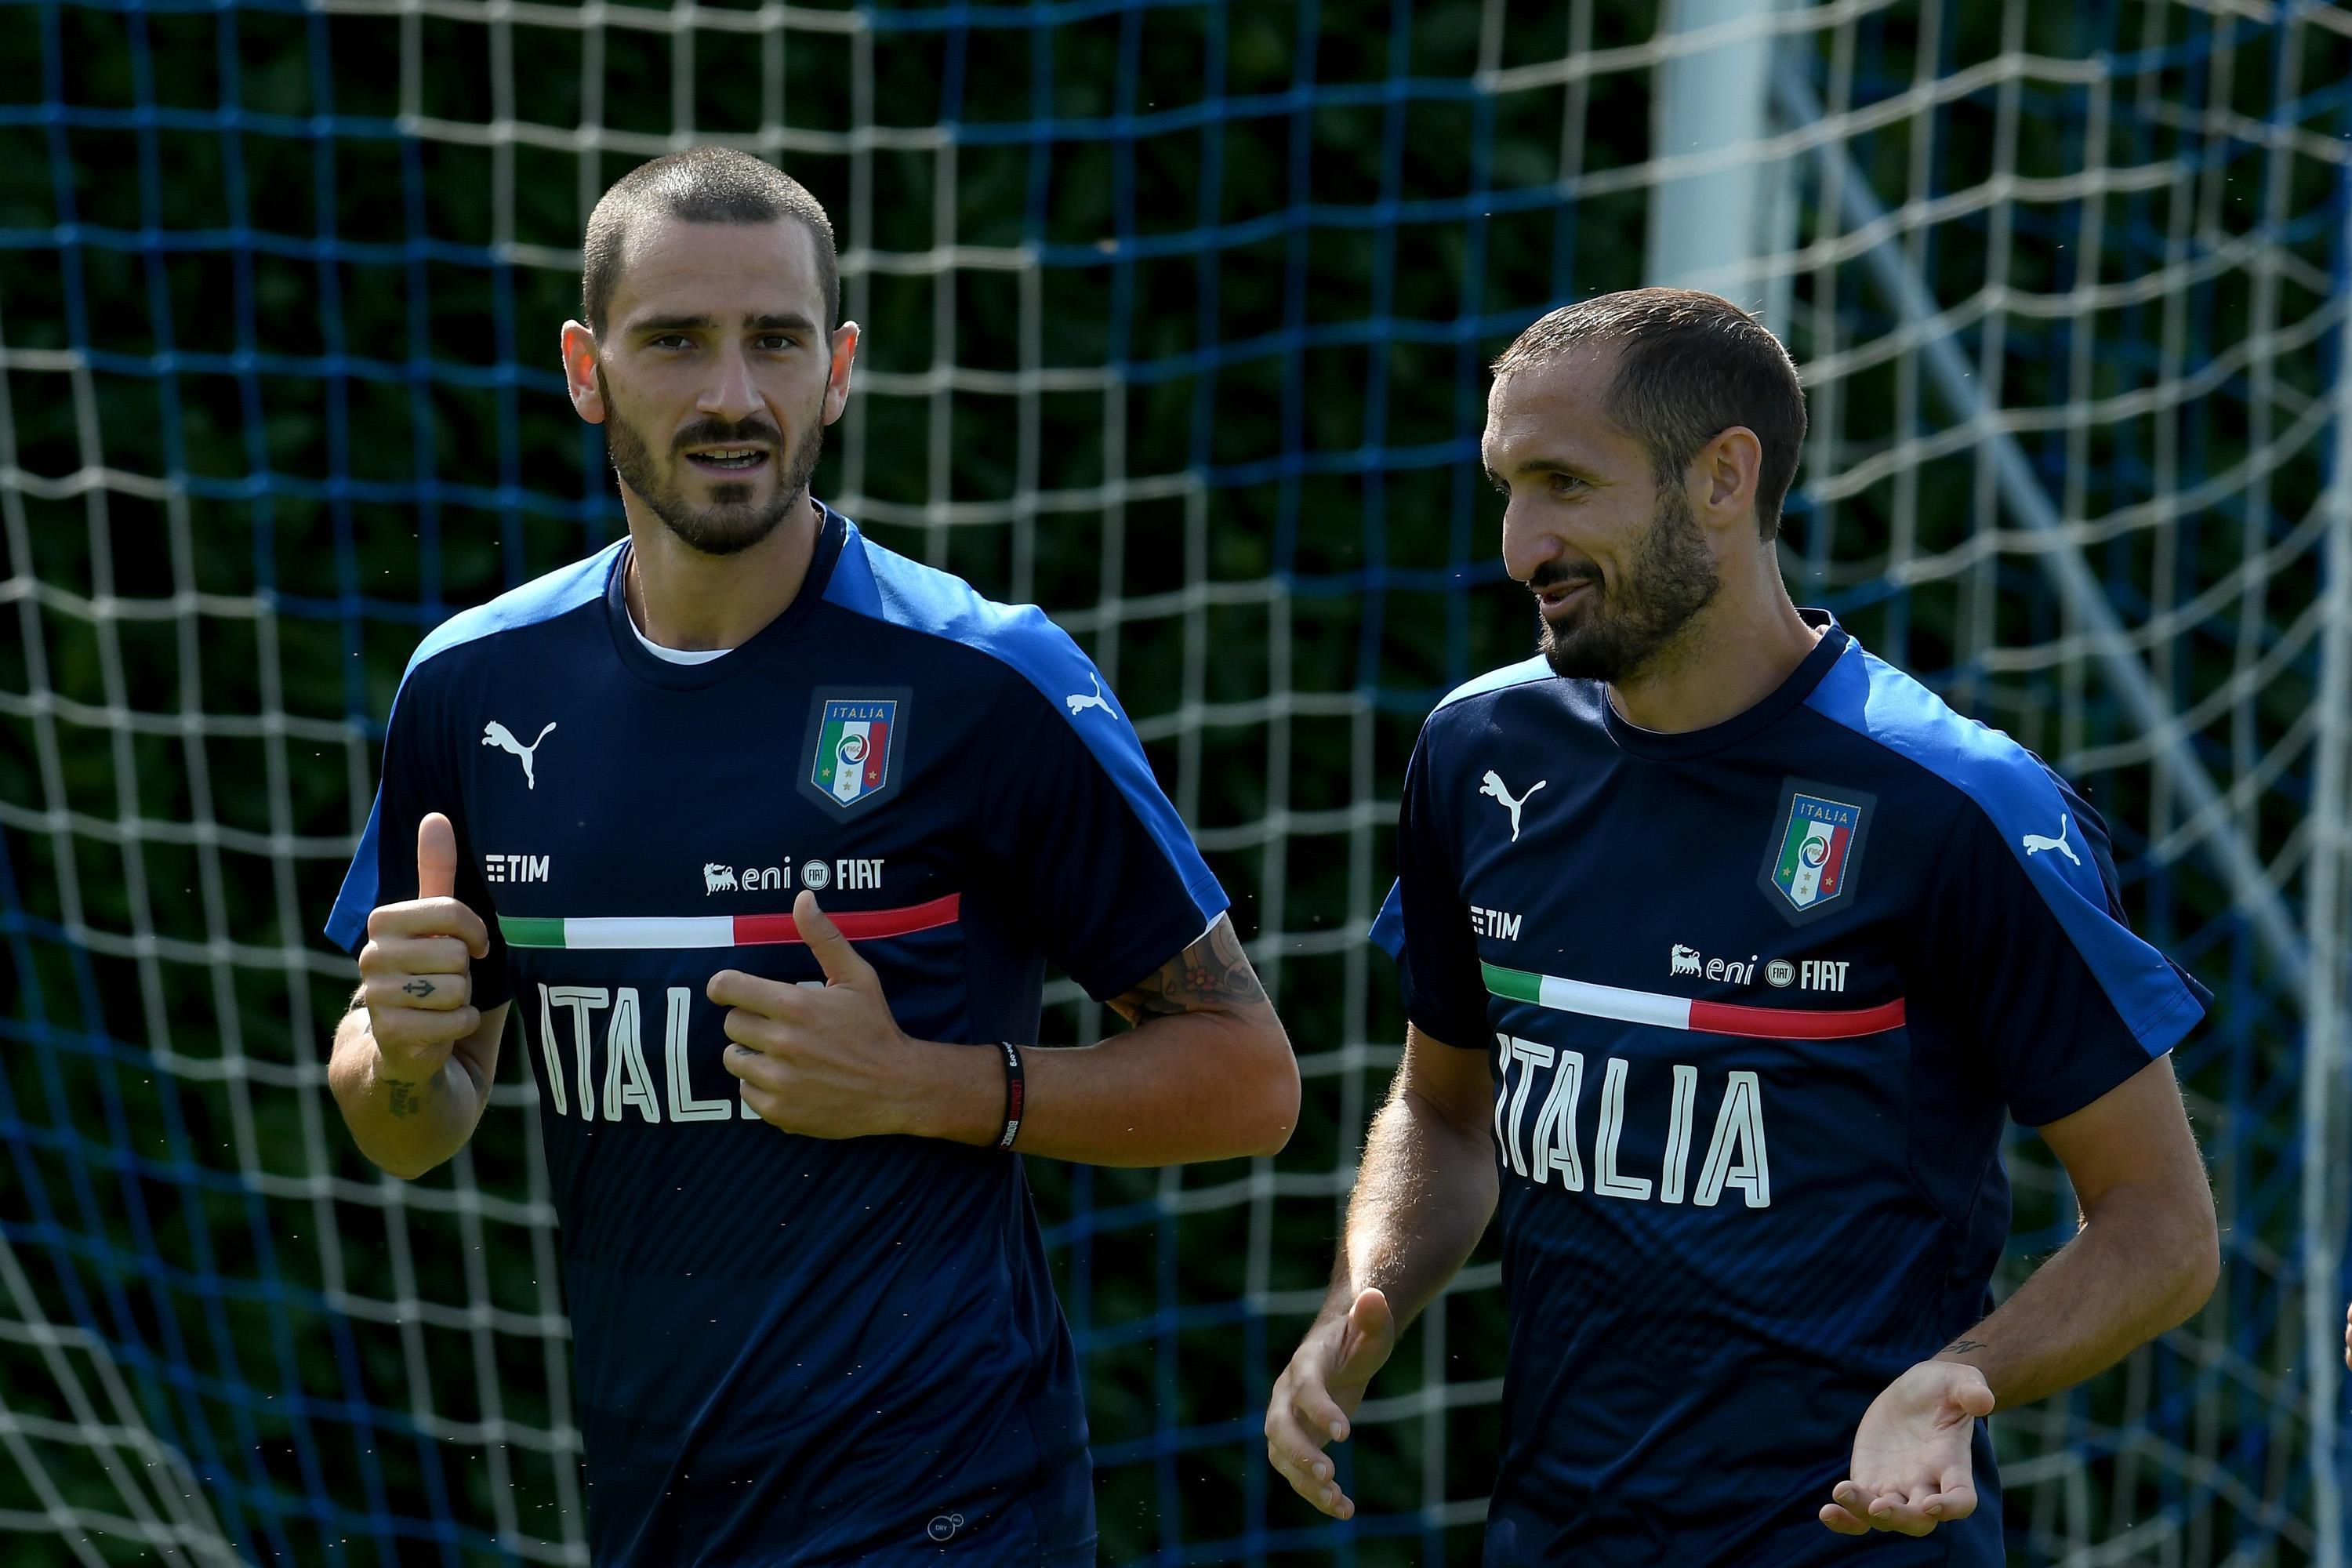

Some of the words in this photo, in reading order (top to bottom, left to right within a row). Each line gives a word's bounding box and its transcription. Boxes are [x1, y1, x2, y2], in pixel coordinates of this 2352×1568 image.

[833, 707, 884, 719] ITALIA
[1800, 803, 1849, 824] ITALIA
[1807, 847, 1822, 857] FIGC
[506, 855, 550, 883] TIM
[742, 855, 791, 891] eni
[808, 868, 825, 882] FIAT
[837, 859, 885, 890] FIAT
[1486, 909, 1523, 941] TIM
[1705, 954, 1759, 985] eni
[1773, 967, 1789, 980] FIAT
[1801, 960, 1850, 993] FIAT
[537, 981, 824, 1123] ITAL
[1494, 1032, 1771, 1209] ITALIA
